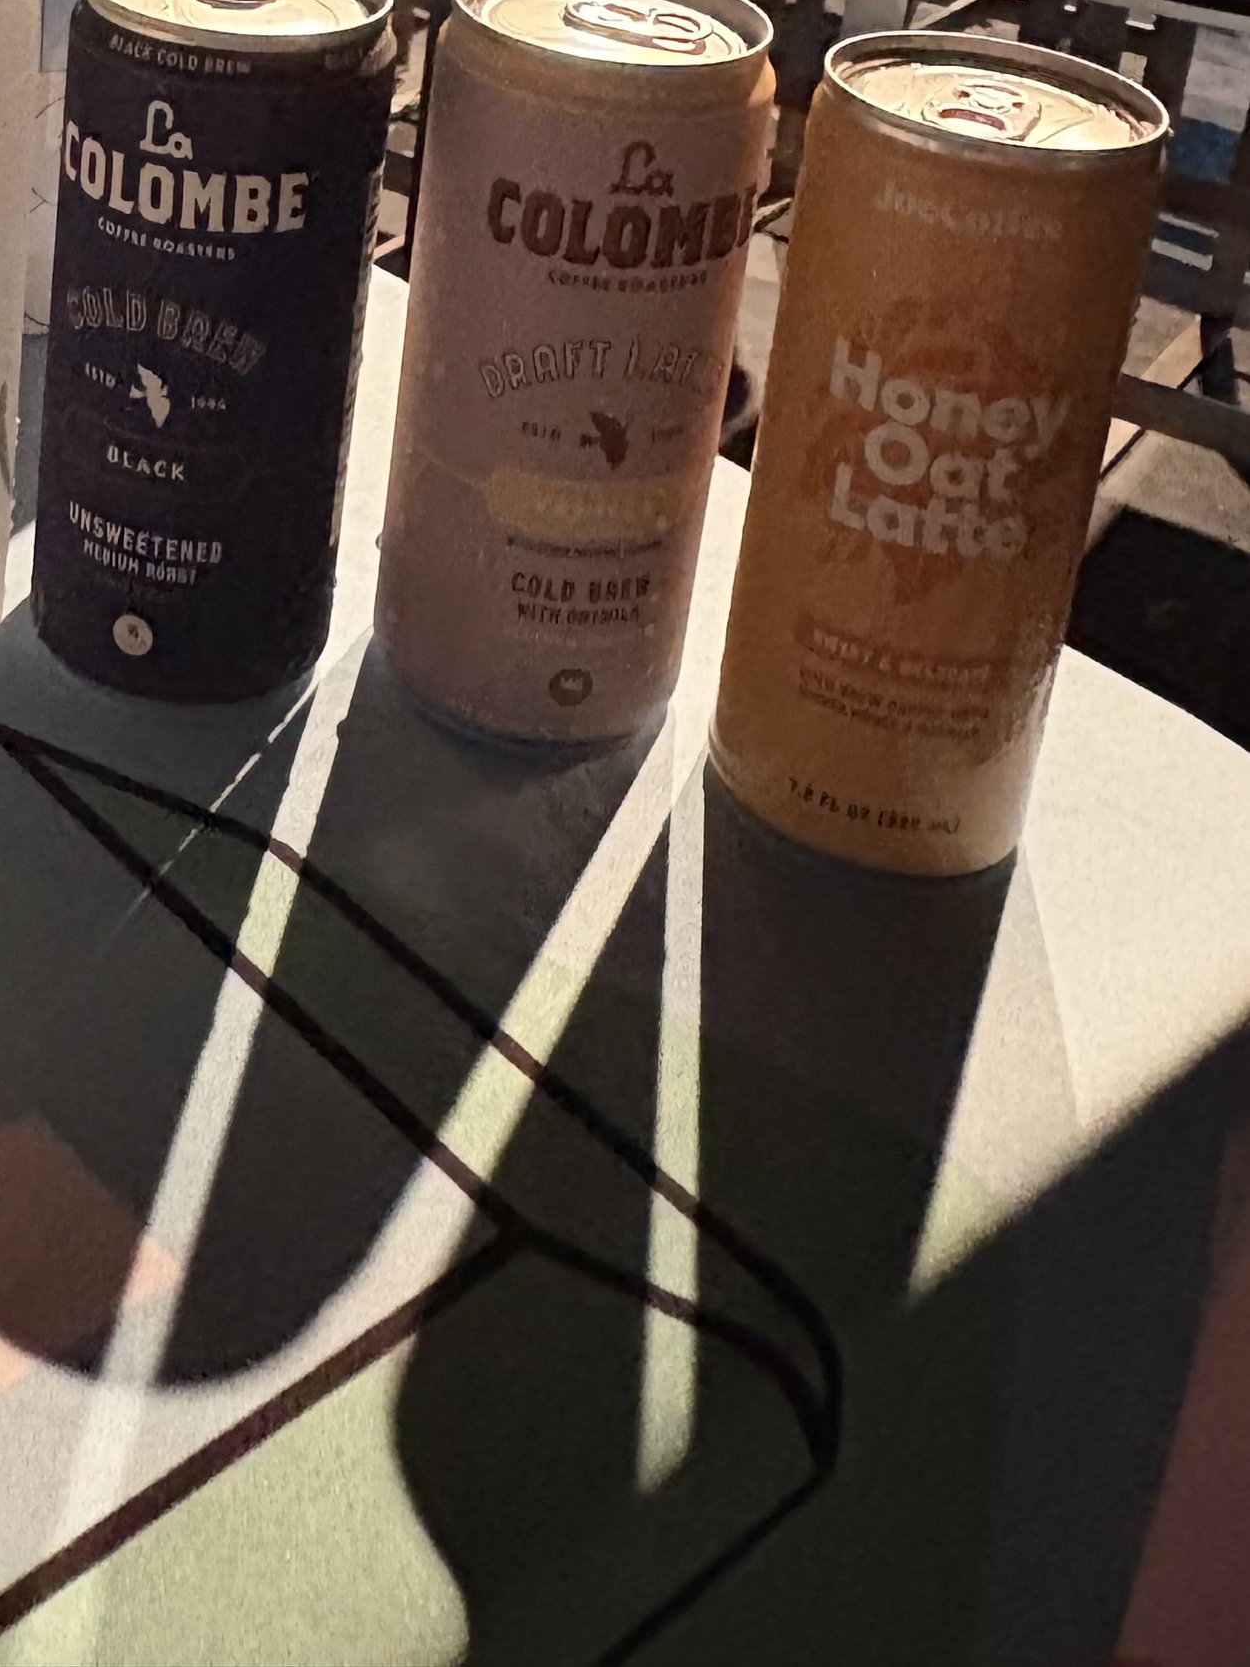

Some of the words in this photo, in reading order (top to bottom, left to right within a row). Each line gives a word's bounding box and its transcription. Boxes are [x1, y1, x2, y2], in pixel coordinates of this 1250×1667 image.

[156, 49, 199, 73] COLD
[138, 99, 194, 161] La
[62, 119, 310, 234] COLOMBE
[609, 140, 675, 198] La
[97, 216, 147, 248] COFFEE
[479, 338, 613, 399] DRAFT
[830, 337, 1072, 458] Honey
[105, 445, 186, 482] BLACK
[863, 420, 1024, 502] Oat
[68, 499, 224, 565] UNSWEETENED
[830, 461, 1029, 559] Latte
[83, 539, 140, 575] MEDIUM
[145, 559, 198, 586] ROAST
[510, 571, 576, 604] COLD
